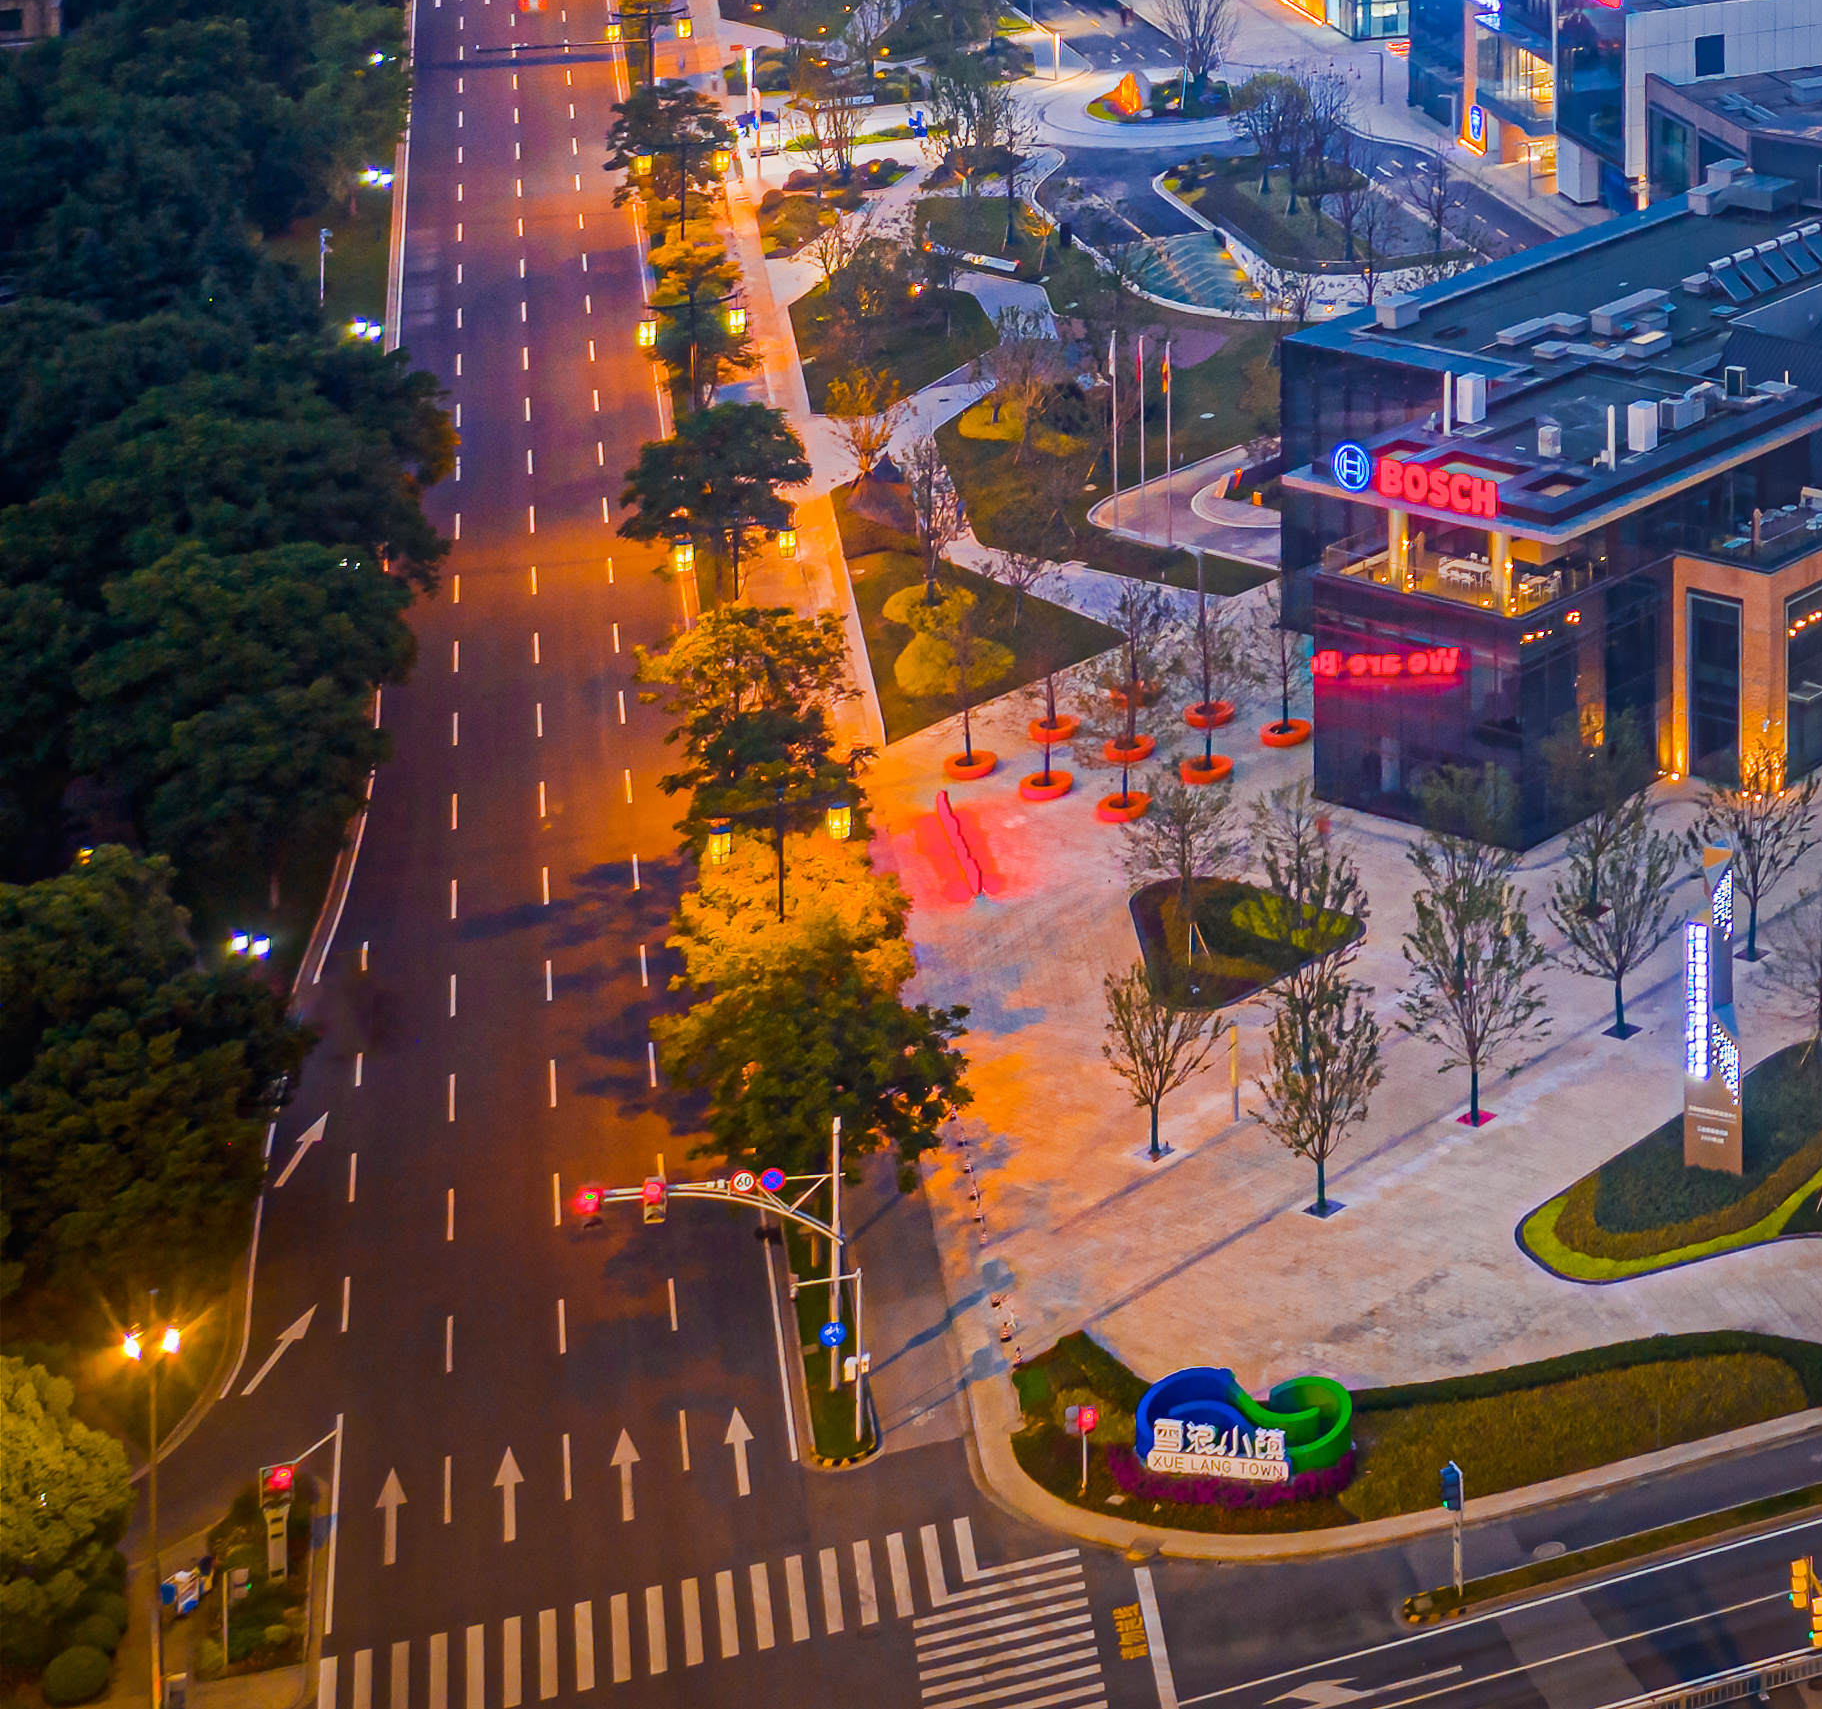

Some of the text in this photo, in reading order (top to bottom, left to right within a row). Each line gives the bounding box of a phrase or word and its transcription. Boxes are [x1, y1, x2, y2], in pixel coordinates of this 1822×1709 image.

[1379, 458, 1498, 519] BOSCH
[737, 1176, 752, 1188] 60
[1153, 1418, 1286, 1461] 雪浪小镇
[1153, 1455, 1284, 1478] XUE LANG TOWN
